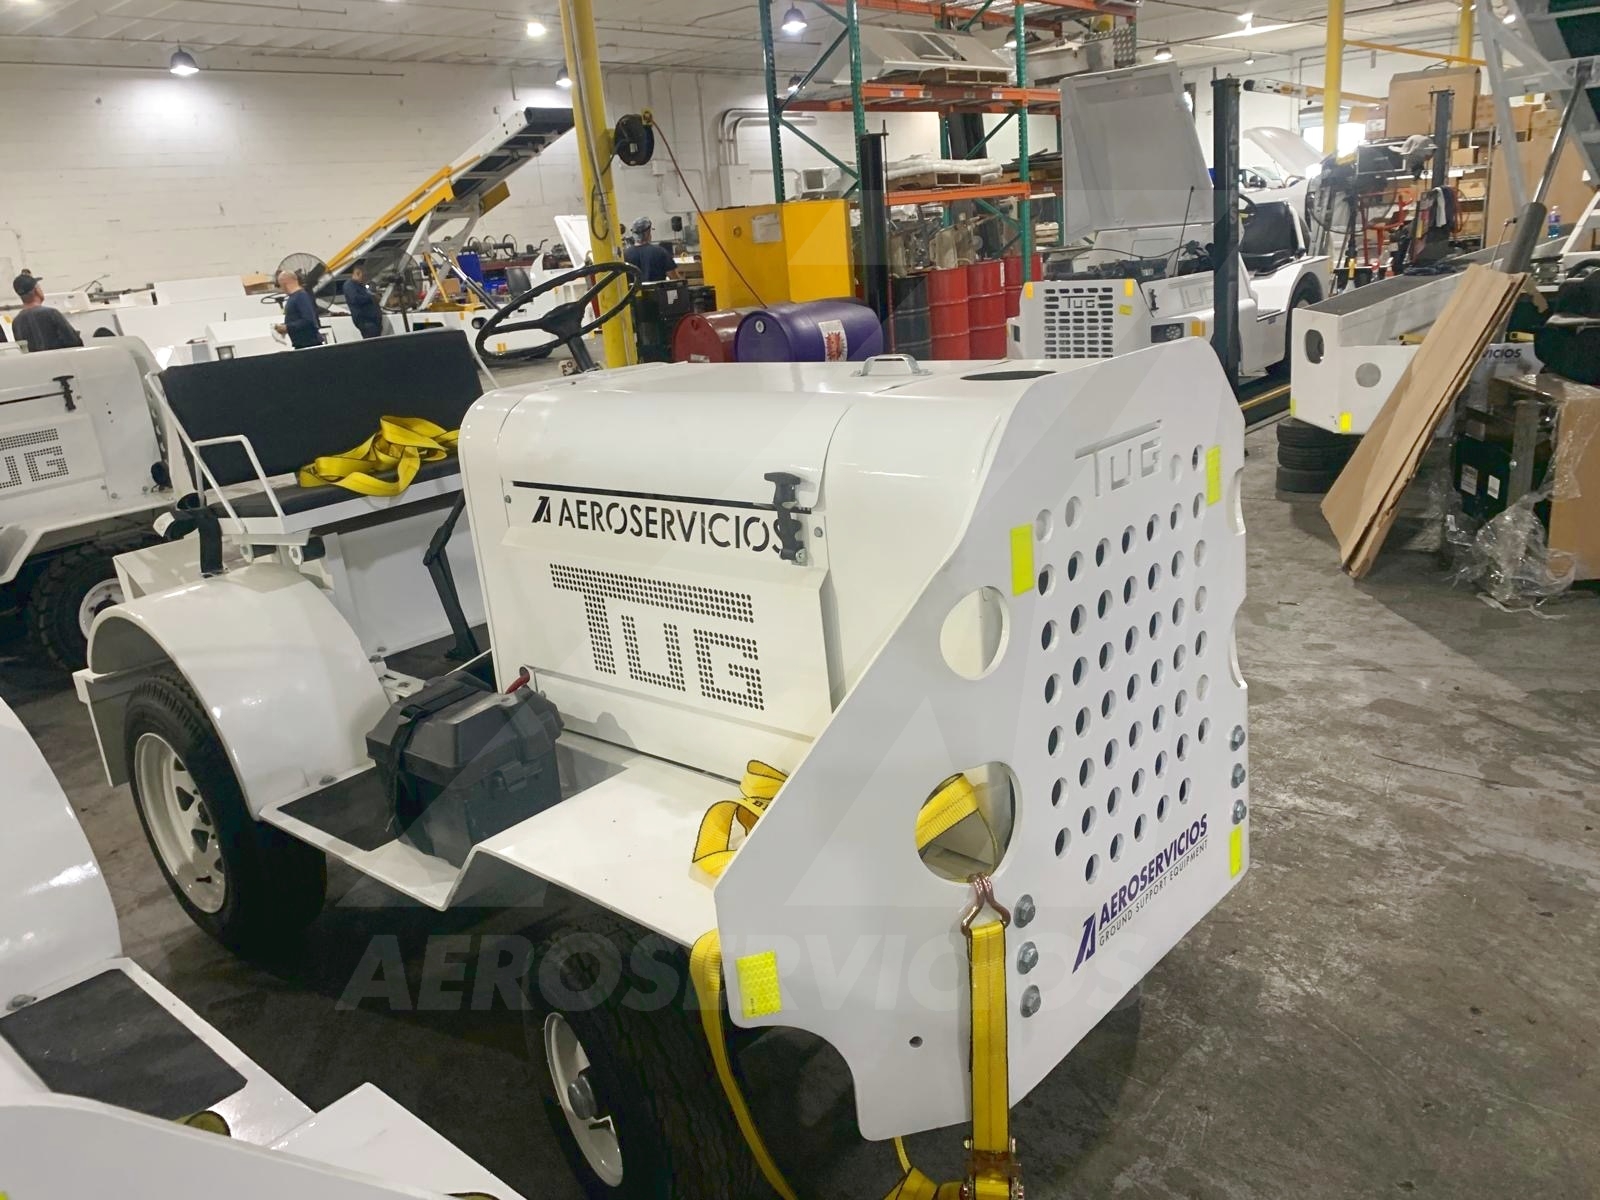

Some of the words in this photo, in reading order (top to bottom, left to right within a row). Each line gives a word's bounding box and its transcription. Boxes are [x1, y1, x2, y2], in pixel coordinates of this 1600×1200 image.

[1060, 295, 1096, 309] TUG
[1075, 419, 1162, 497] TUG
[550, 563, 765, 711] TUG
[1099, 813, 1208, 931] AEROSERVICIOS
[1099, 909, 1133, 946] GROUND
[1135, 876, 1168, 913] SUPPORT
[1169, 839, 1208, 881] EQUIPMENT
